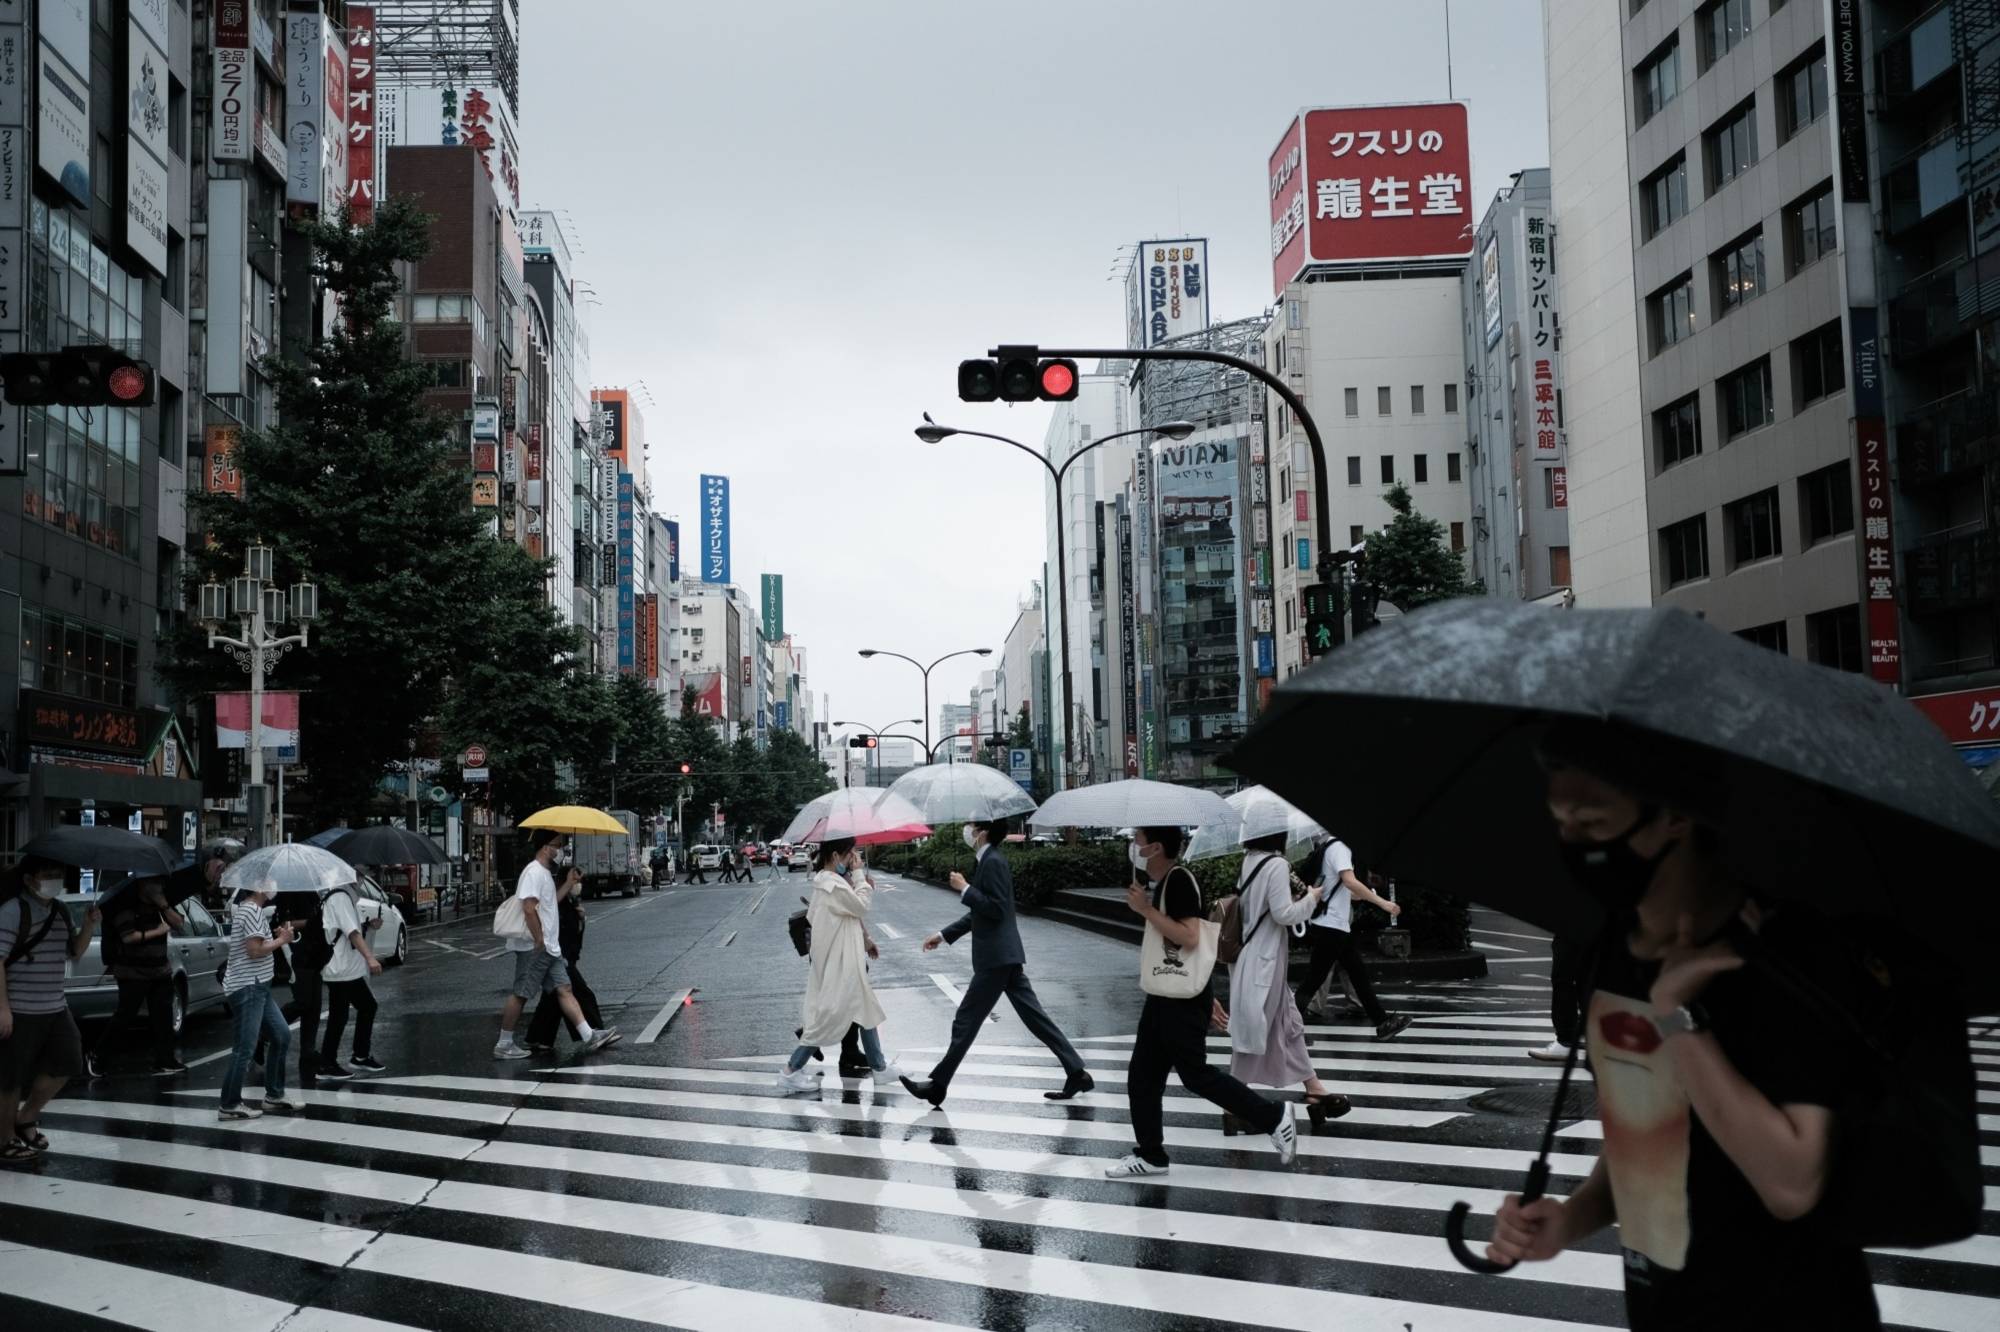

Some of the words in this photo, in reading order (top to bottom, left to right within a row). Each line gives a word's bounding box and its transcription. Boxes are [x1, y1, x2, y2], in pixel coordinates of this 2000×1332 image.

[218, 51, 246, 63] 全品
[1841, 31, 1855, 83] WOMAN
[221, 63, 242, 147] 270円均一
[1328, 129, 1443, 157] クスリの
[1271, 146, 1300, 200] クスリの
[1316, 173, 1464, 220] 龍生堂
[1272, 190, 1304, 257] 龍生堂
[1184, 264, 1200, 298] NEW
[1528, 217, 1549, 347] 新宿サンパーク
[1860, 339, 1877, 389] Vitule
[212, 452, 224, 488] セット
[1865, 440, 1884, 510] クスリの
[710, 496, 723, 578] オザキクリニック
[1865, 516, 1893, 599] 龍生堂
[1871, 640, 1898, 648] HEALTH
[1872, 655, 1898, 663] BEAUTY
[1012, 751, 1025, 769] P
[1127, 741, 1137, 768] KFC
